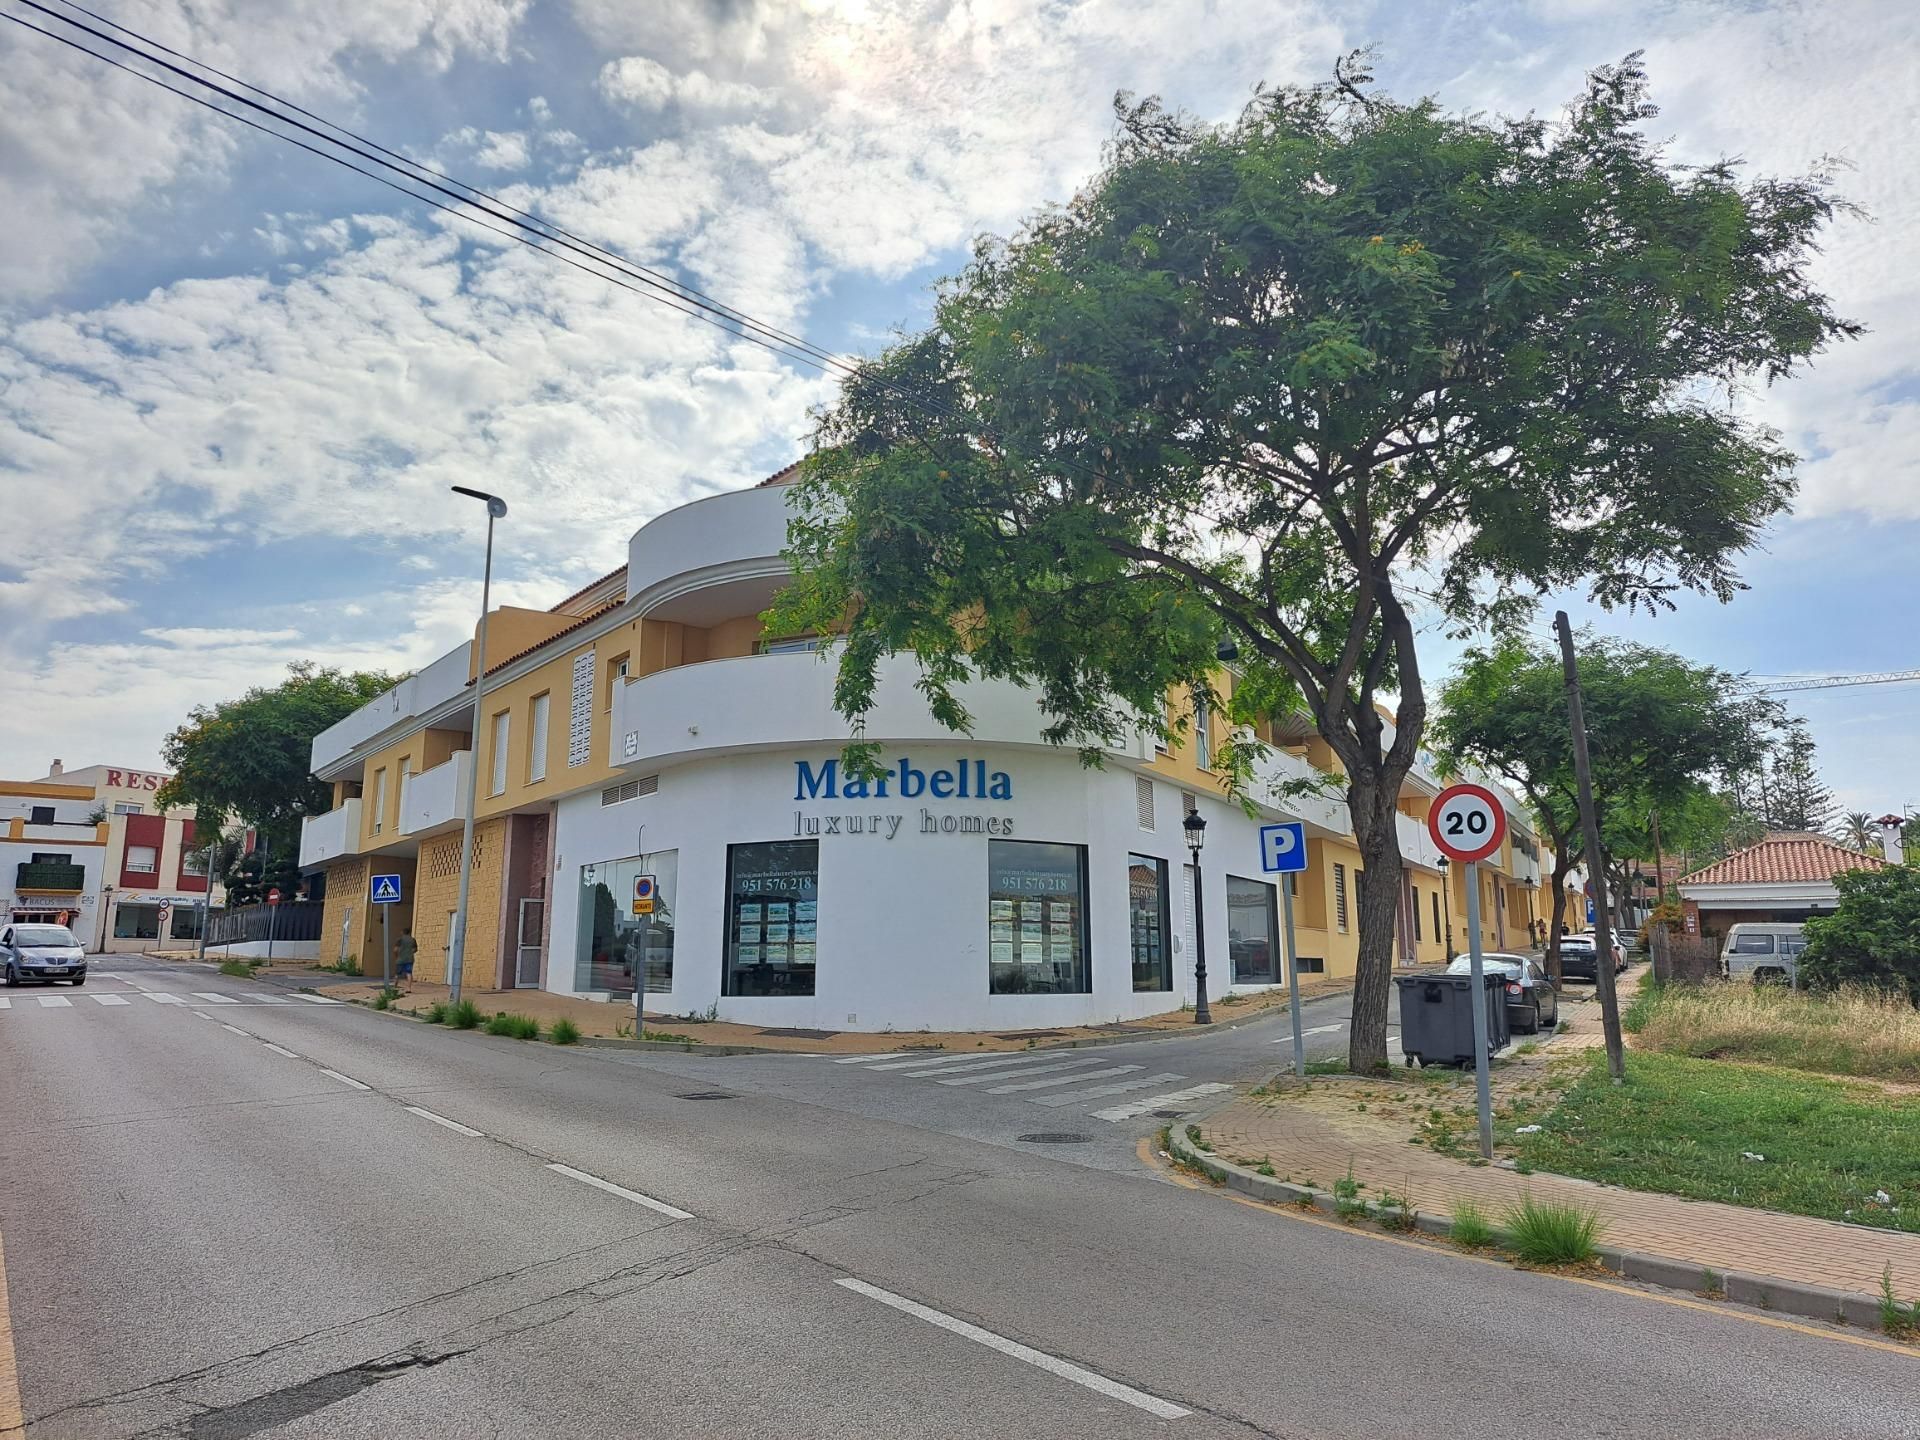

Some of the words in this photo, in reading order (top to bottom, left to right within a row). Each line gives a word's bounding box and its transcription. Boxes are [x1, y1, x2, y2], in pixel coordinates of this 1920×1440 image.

[794, 757, 1013, 801] Marbella
[793, 811, 902, 839] luxury
[919, 808, 1014, 835] homes
[1446, 810, 1487, 835] 20
[1263, 828, 1296, 870] P
[742, 880, 761, 891] 951
[766, 878, 787, 890] 576
[790, 876, 812, 890] 218
[1002, 877, 1021, 889] 951
[1025, 878, 1045, 890] 576
[1047, 879, 1067, 891] 218
